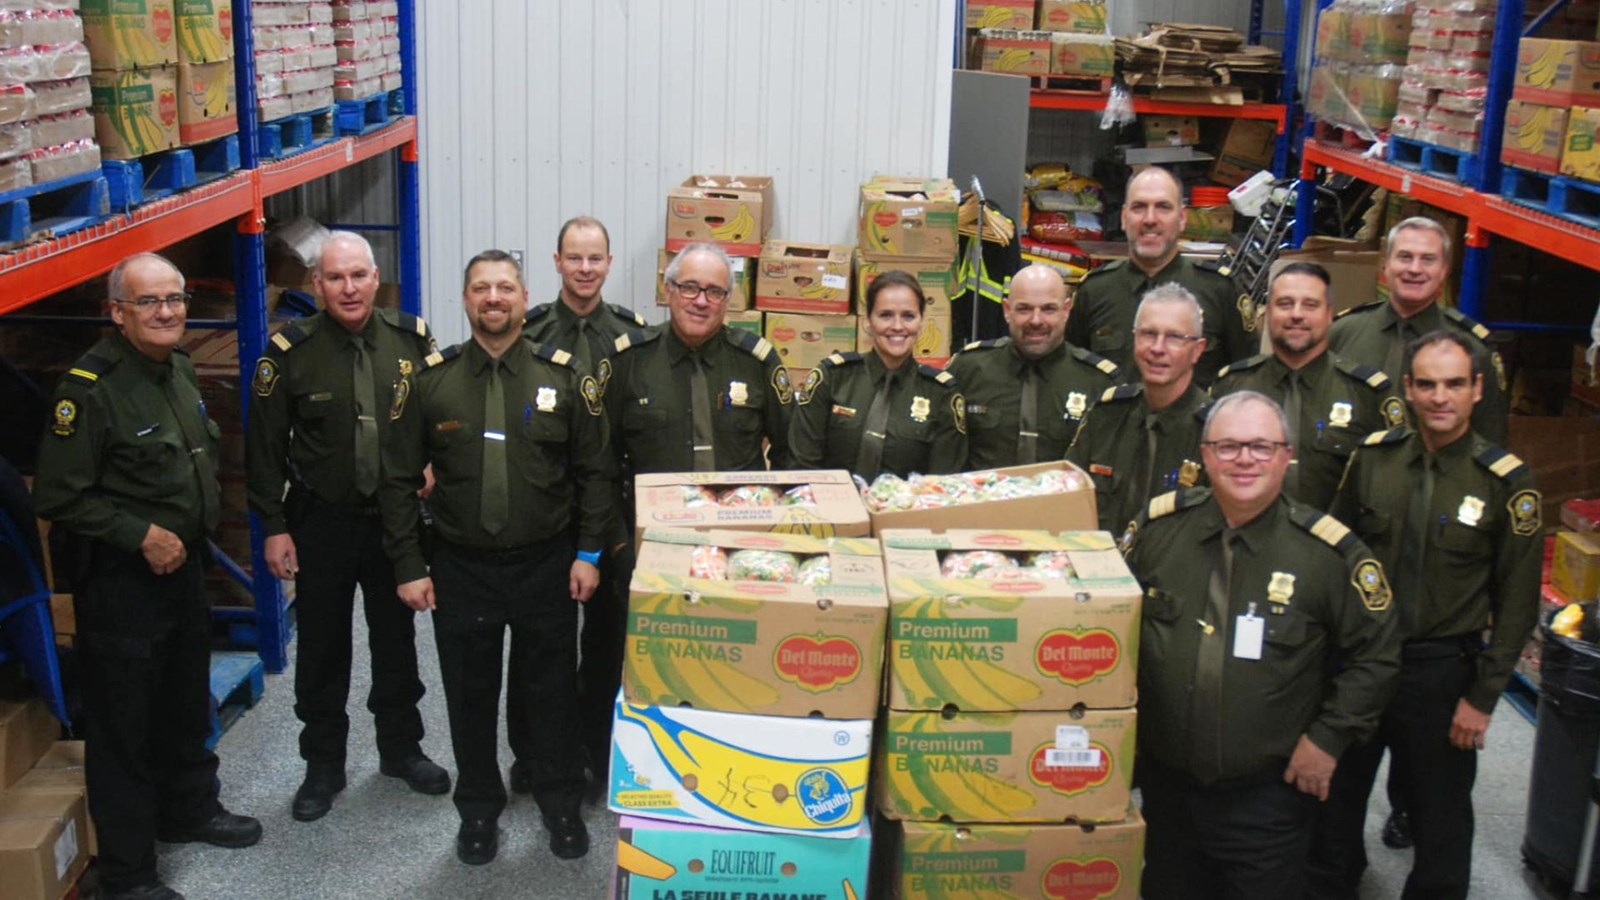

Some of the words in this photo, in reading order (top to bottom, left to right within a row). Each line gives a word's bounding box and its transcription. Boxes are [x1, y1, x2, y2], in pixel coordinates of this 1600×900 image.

[637, 616, 729, 639] Premium
[899, 621, 990, 639] Premium
[636, 639, 743, 663] BANANAS
[782, 649, 805, 665] Del
[808, 650, 857, 668] Monte
[899, 644, 1004, 662] BANANAS
[1042, 646, 1065, 661] Del
[1069, 645, 1115, 661] Monte
[896, 735, 984, 751] Premium
[896, 756, 999, 773] BNANAS
[805, 793, 851, 819] Chiquita
[710, 849, 777, 876] EQUIFRUIT
[911, 856, 998, 872] Premium
[911, 876, 1012, 892] BNANAS
[652, 889, 677, 900] LA
